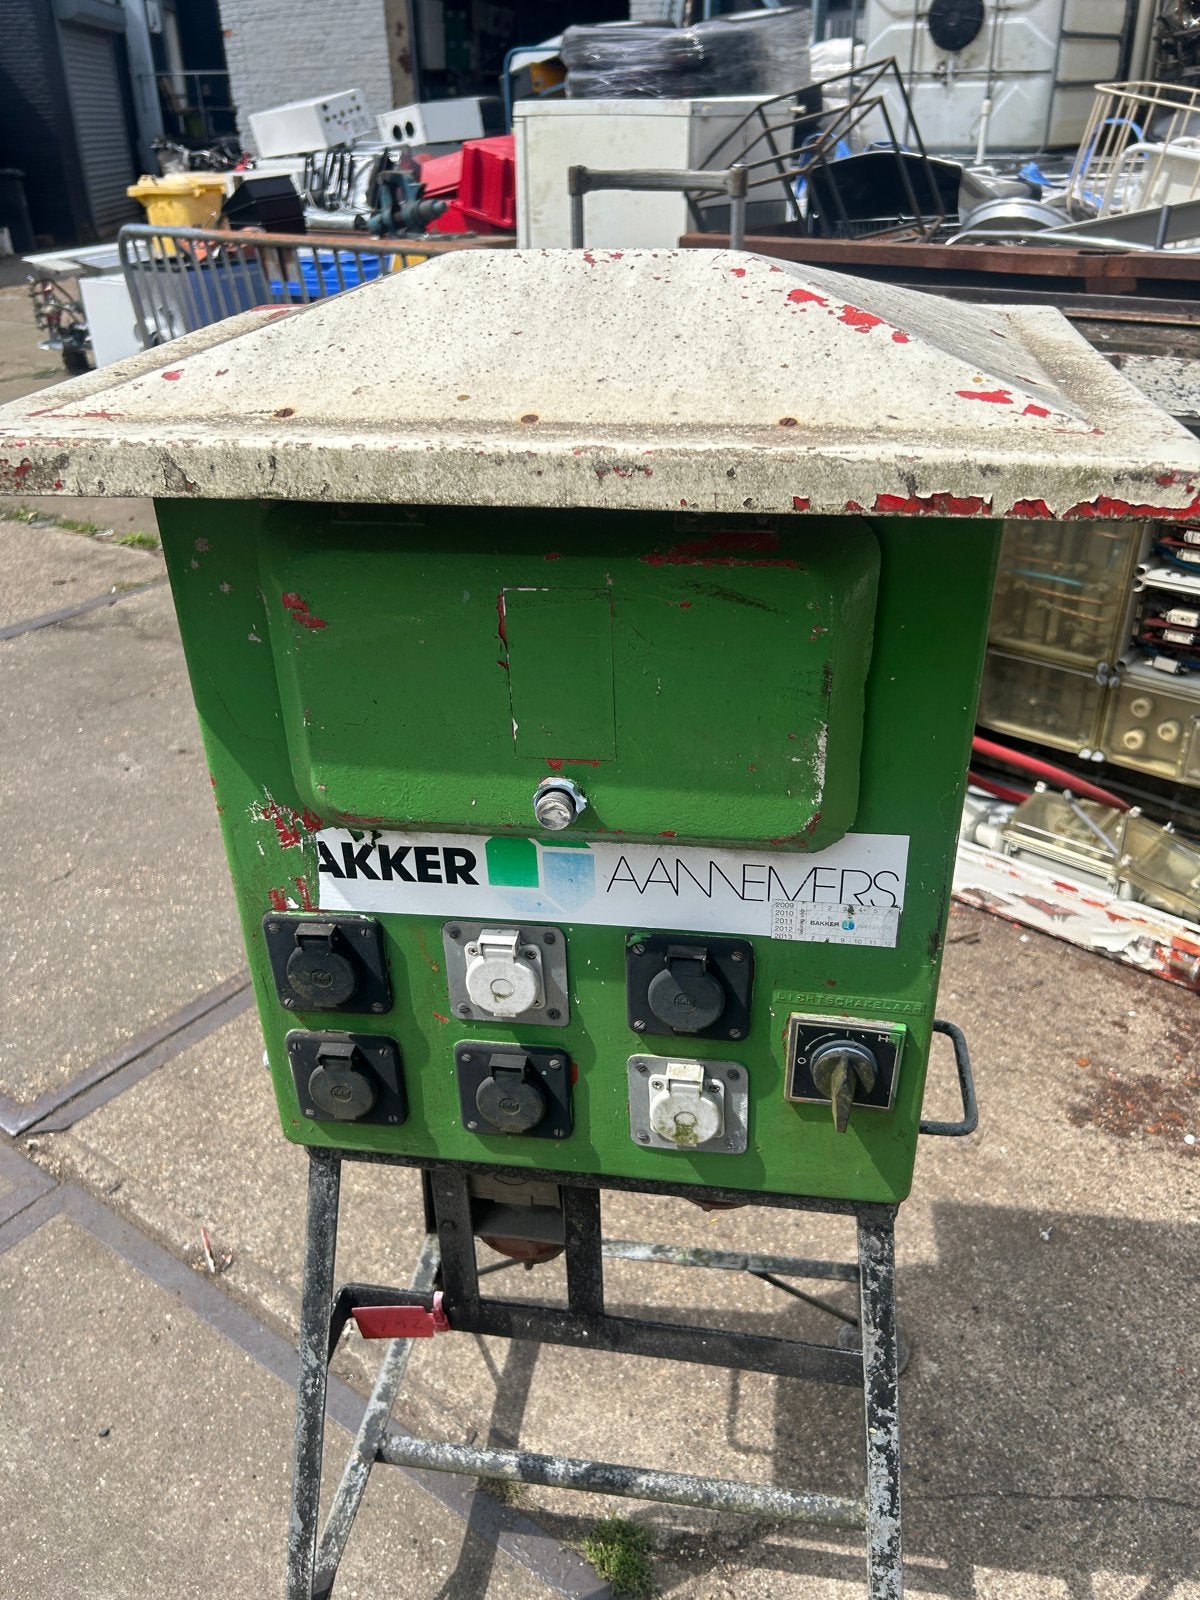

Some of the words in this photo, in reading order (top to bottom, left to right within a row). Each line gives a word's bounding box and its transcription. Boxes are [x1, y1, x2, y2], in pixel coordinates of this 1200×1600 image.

[607, 856, 900, 908] AANNEMERS
[775, 901, 795, 909] 2009
[775, 909, 794, 917] 2010
[774, 917, 793, 925] 2011
[774, 932, 793, 940] 2013
